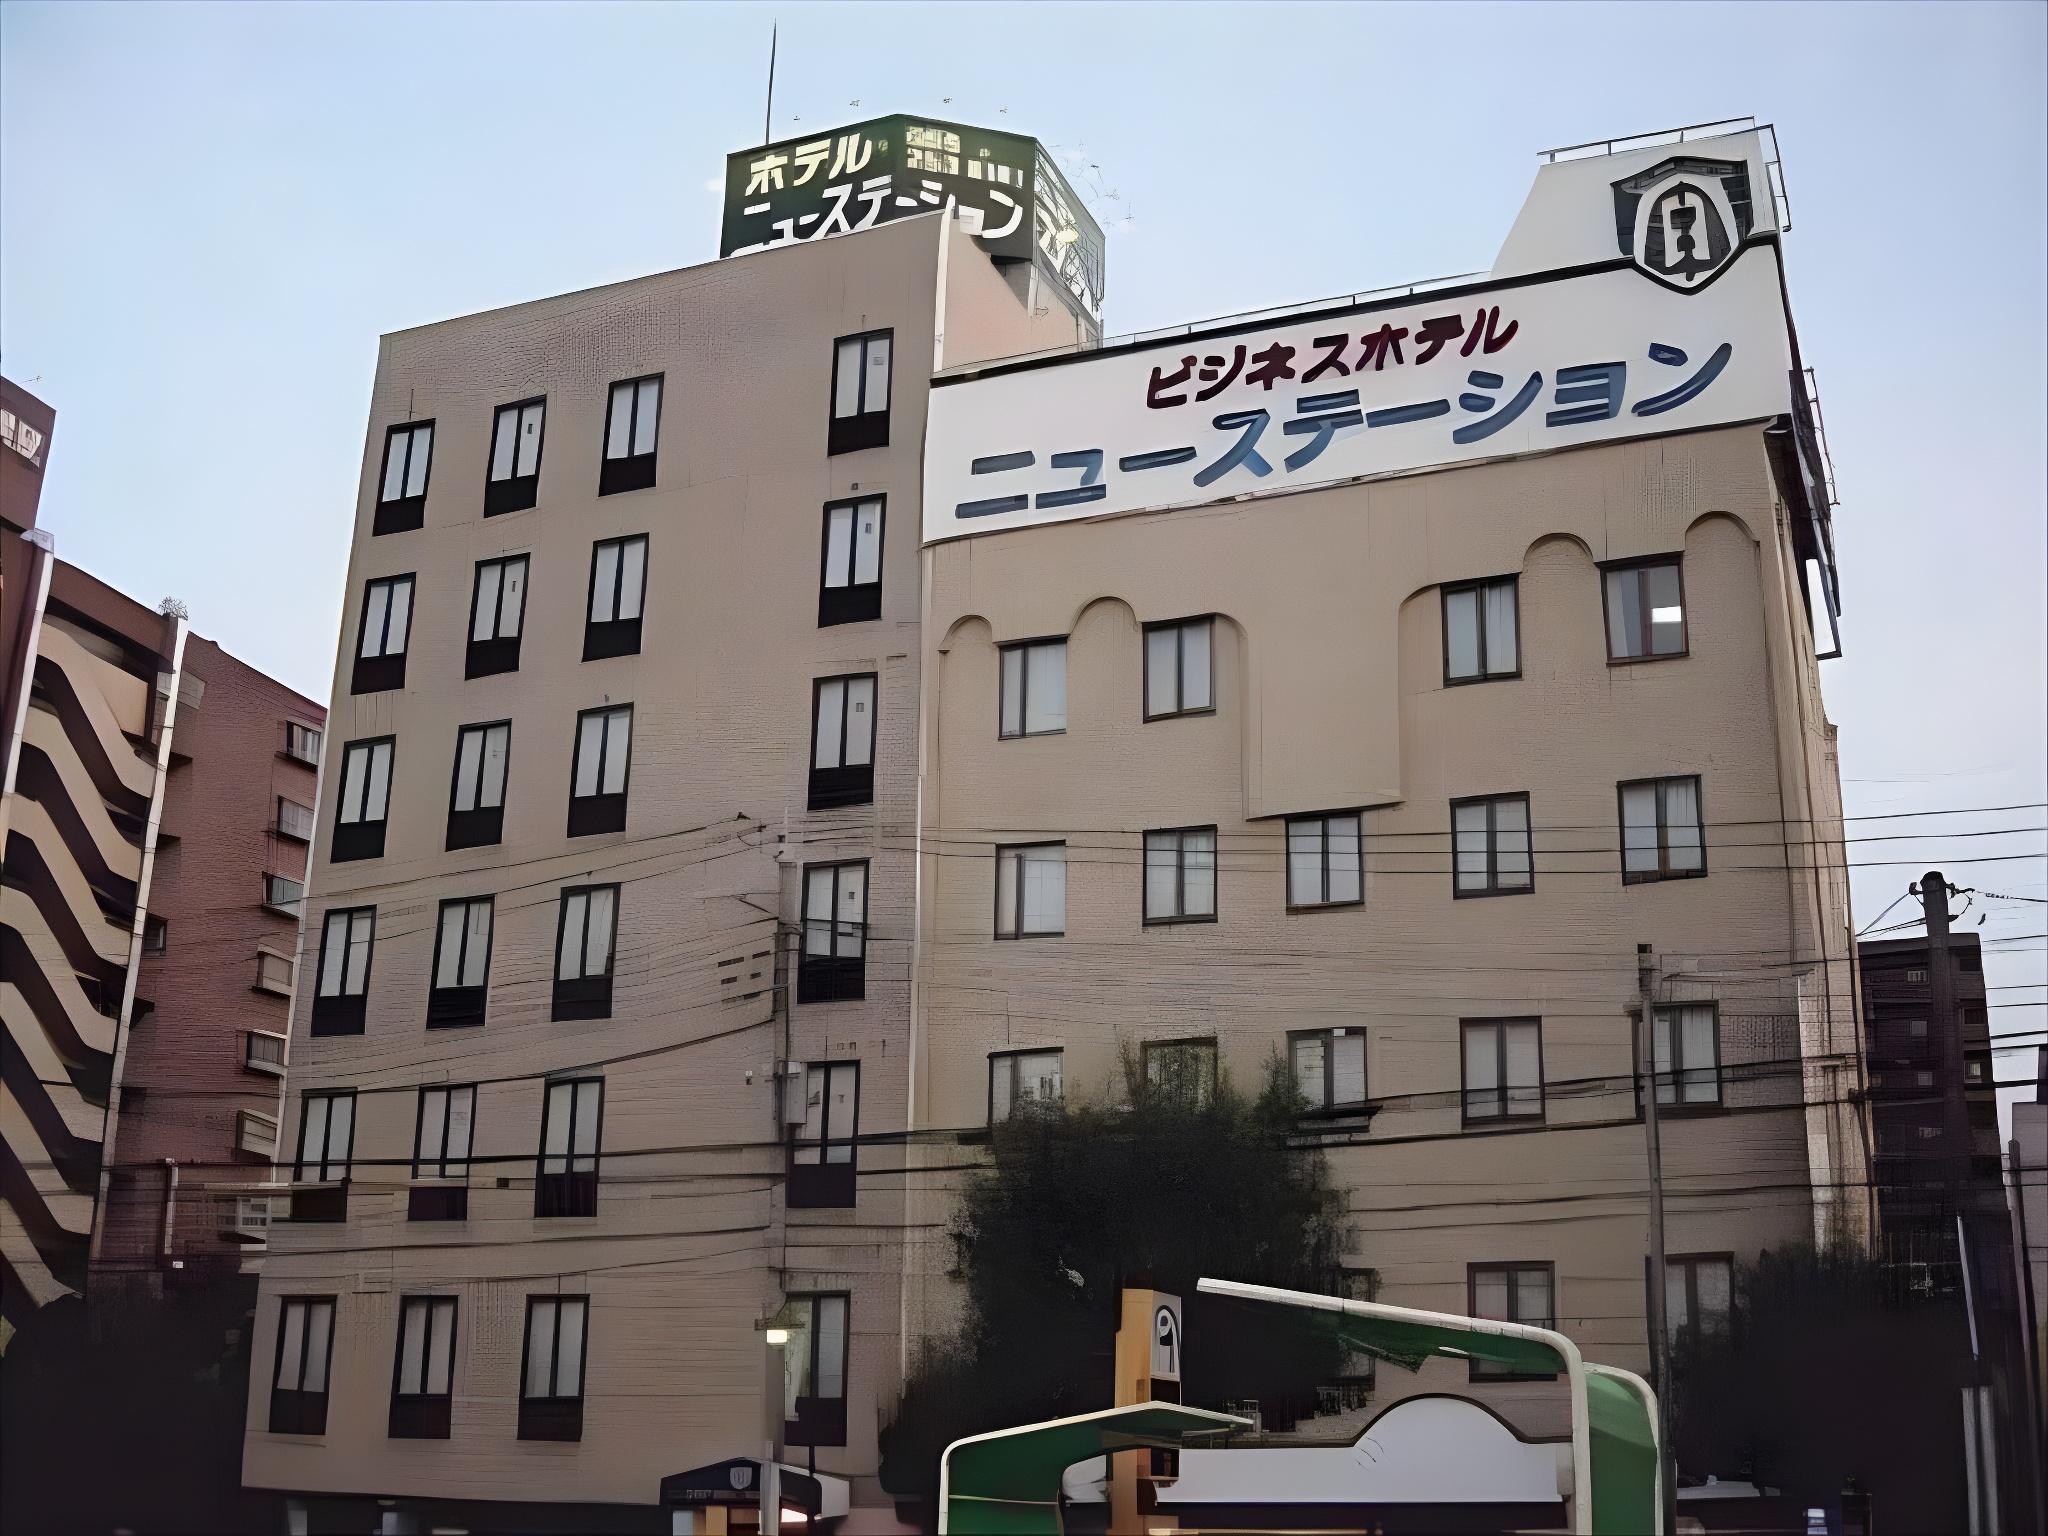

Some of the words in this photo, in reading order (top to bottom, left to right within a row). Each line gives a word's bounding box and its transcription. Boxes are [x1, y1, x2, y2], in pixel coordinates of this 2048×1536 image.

[745, 133, 873, 196] ホテル
[1147, 305, 1519, 408] ビジネスホテル
[956, 341, 1733, 519] ニューステーション
